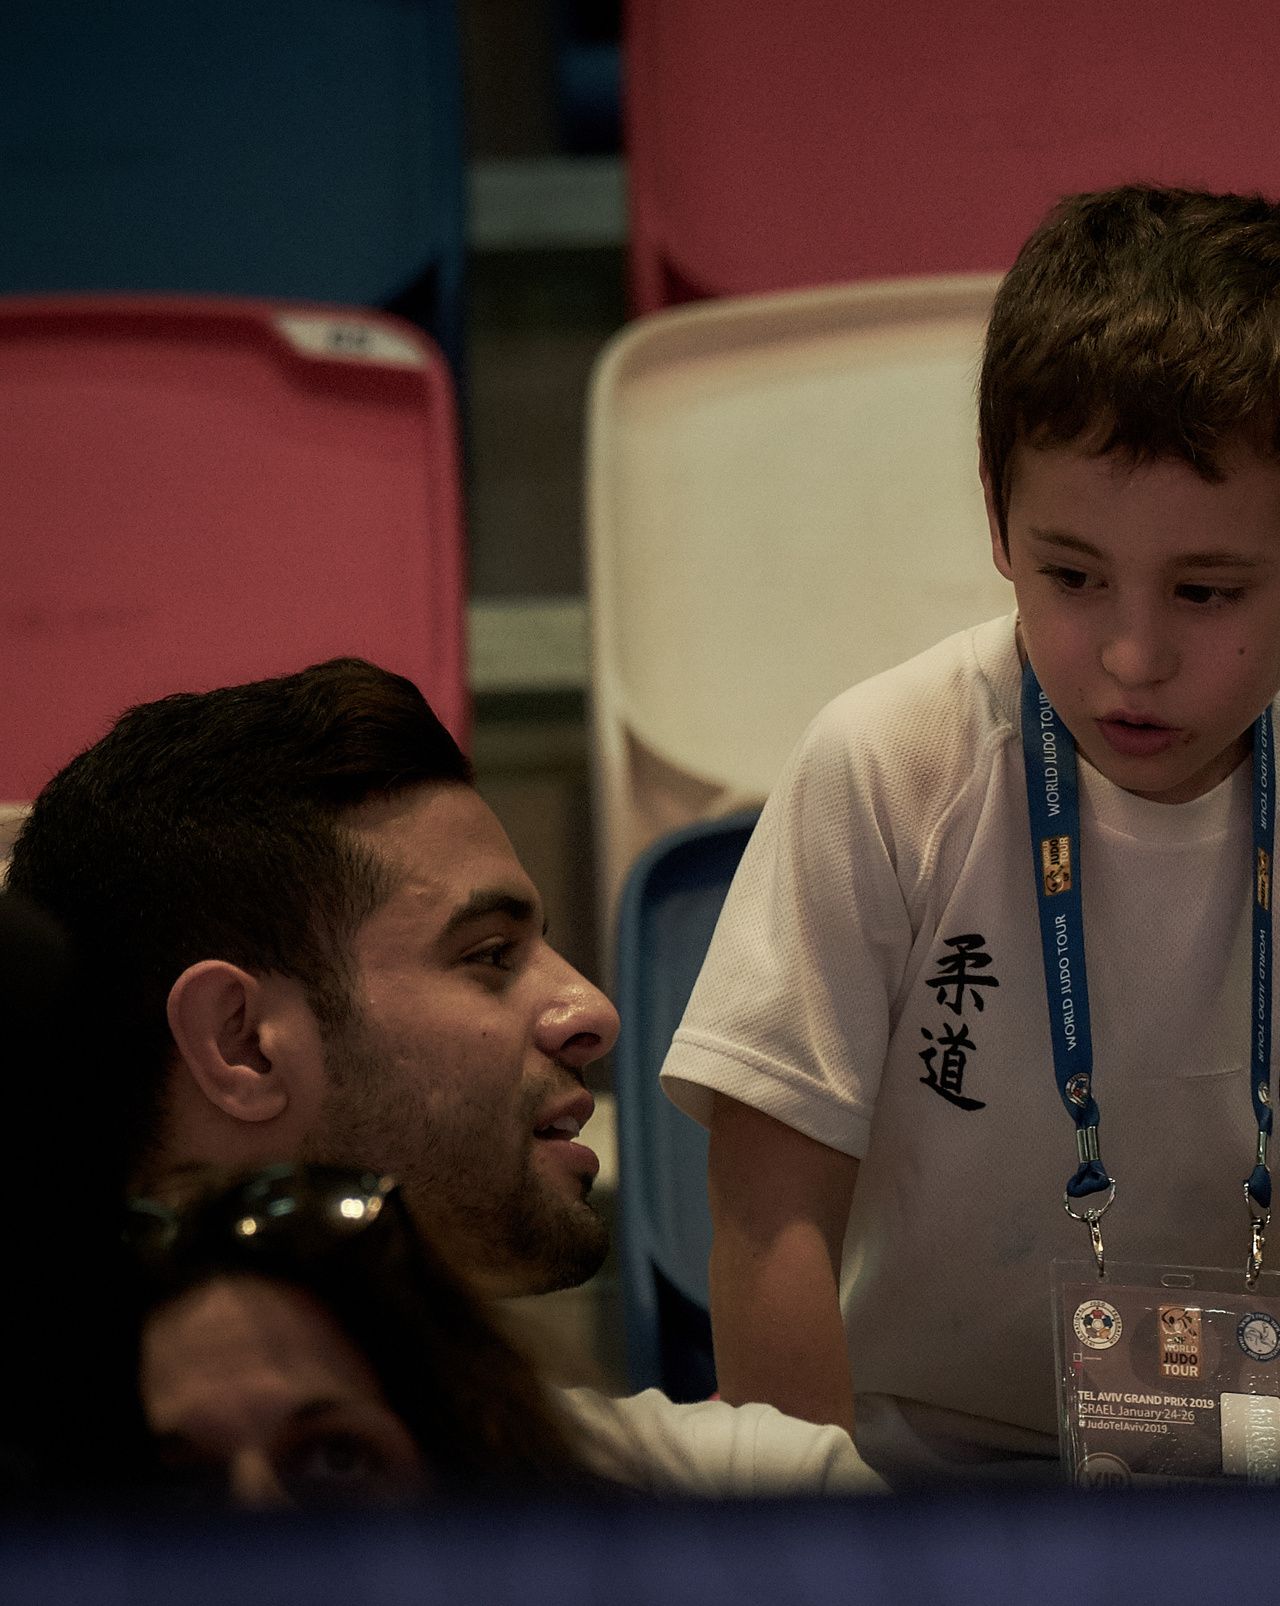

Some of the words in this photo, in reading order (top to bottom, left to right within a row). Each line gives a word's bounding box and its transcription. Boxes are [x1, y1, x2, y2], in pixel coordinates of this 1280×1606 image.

[1042, 732, 1057, 765] JUDO
[1260, 749, 1268, 788] JUDO
[1045, 767, 1060, 817] WORLD
[1259, 790, 1268, 830] TOUR
[1050, 839, 1060, 865] JUDO
[1059, 836, 1069, 864] TOUR
[1055, 914, 1068, 955] TOUR
[1058, 957, 1072, 994] JUDO
[1258, 981, 1266, 1021] JUDO
[1062, 999, 1077, 1051] WORLD
[1257, 1023, 1265, 1063] TOUR
[1163, 1343, 1198, 1354] WORLD
[1163, 1352, 1198, 1365] JUDO
[1163, 1364, 1199, 1377] TOUR
[1077, 1390, 1096, 1401] TEL
[1096, 1392, 1123, 1403] AVIV
[1123, 1393, 1163, 1406] GRAND
[1163, 1396, 1189, 1407] PRIX
[1189, 1398, 1215, 1409] 2019
[1079, 1403, 1116, 1416] ISRAEL
[1118, 1405, 1162, 1420] January
[1163, 1409, 1195, 1421] 24-26
